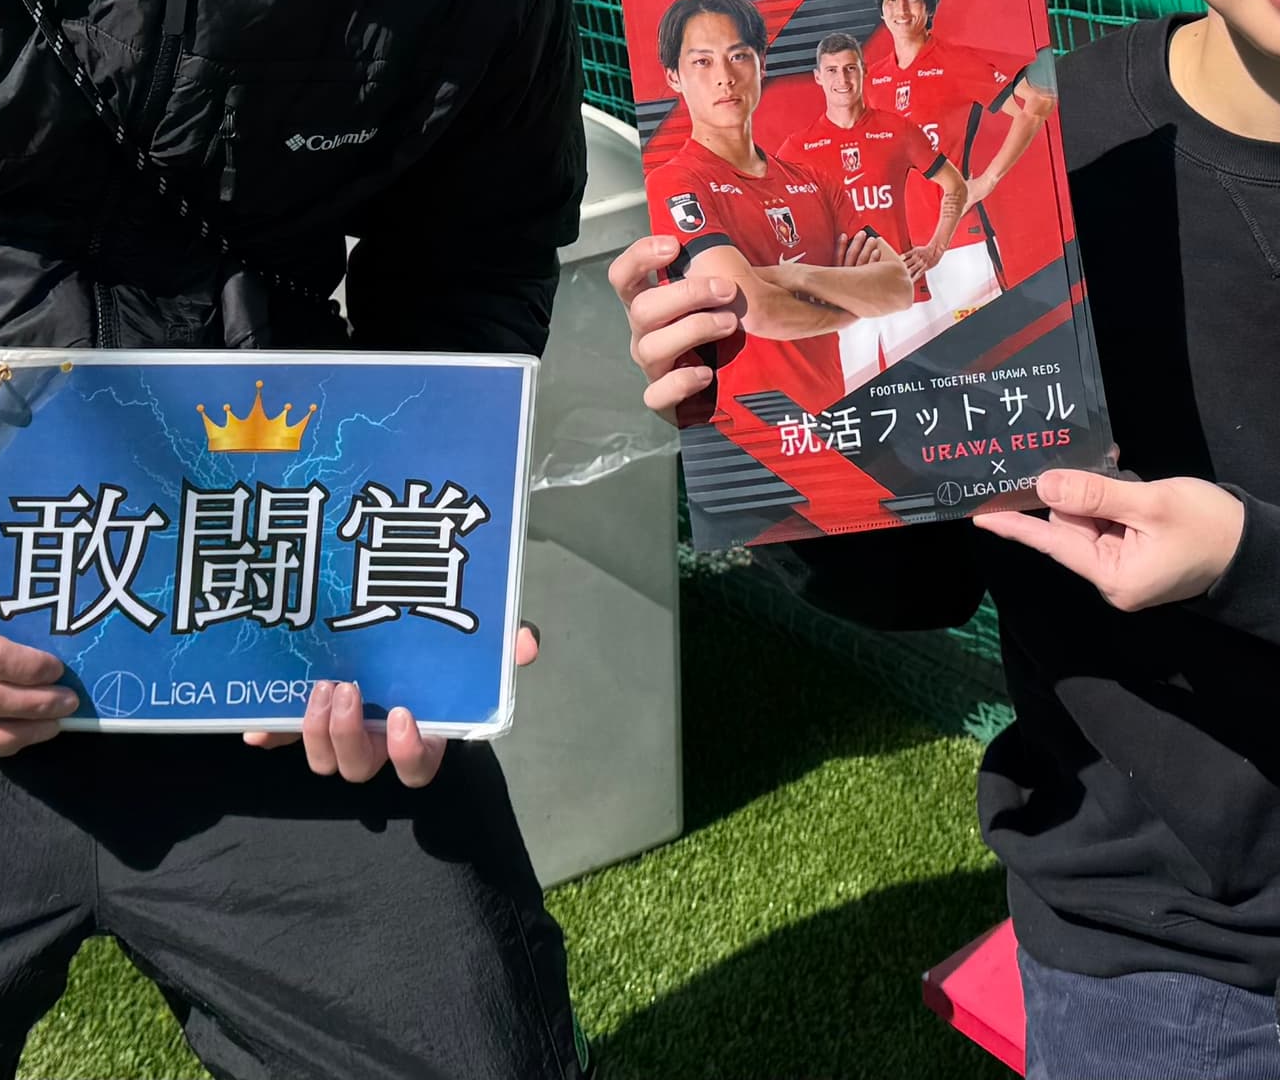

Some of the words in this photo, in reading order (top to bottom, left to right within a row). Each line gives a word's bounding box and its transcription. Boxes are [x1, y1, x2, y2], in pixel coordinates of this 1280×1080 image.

[845, 184, 894, 212] LUS
[869, 381, 926, 398] FOOTBALL
[930, 372, 987, 389] TOGETHER
[991, 367, 1028, 382] URAWA
[1032, 363, 1061, 377] REDS
[776, 382, 1076, 458] 就活フットサル
[921, 436, 1004, 464] URAWA
[1010, 427, 1072, 452] REDS
